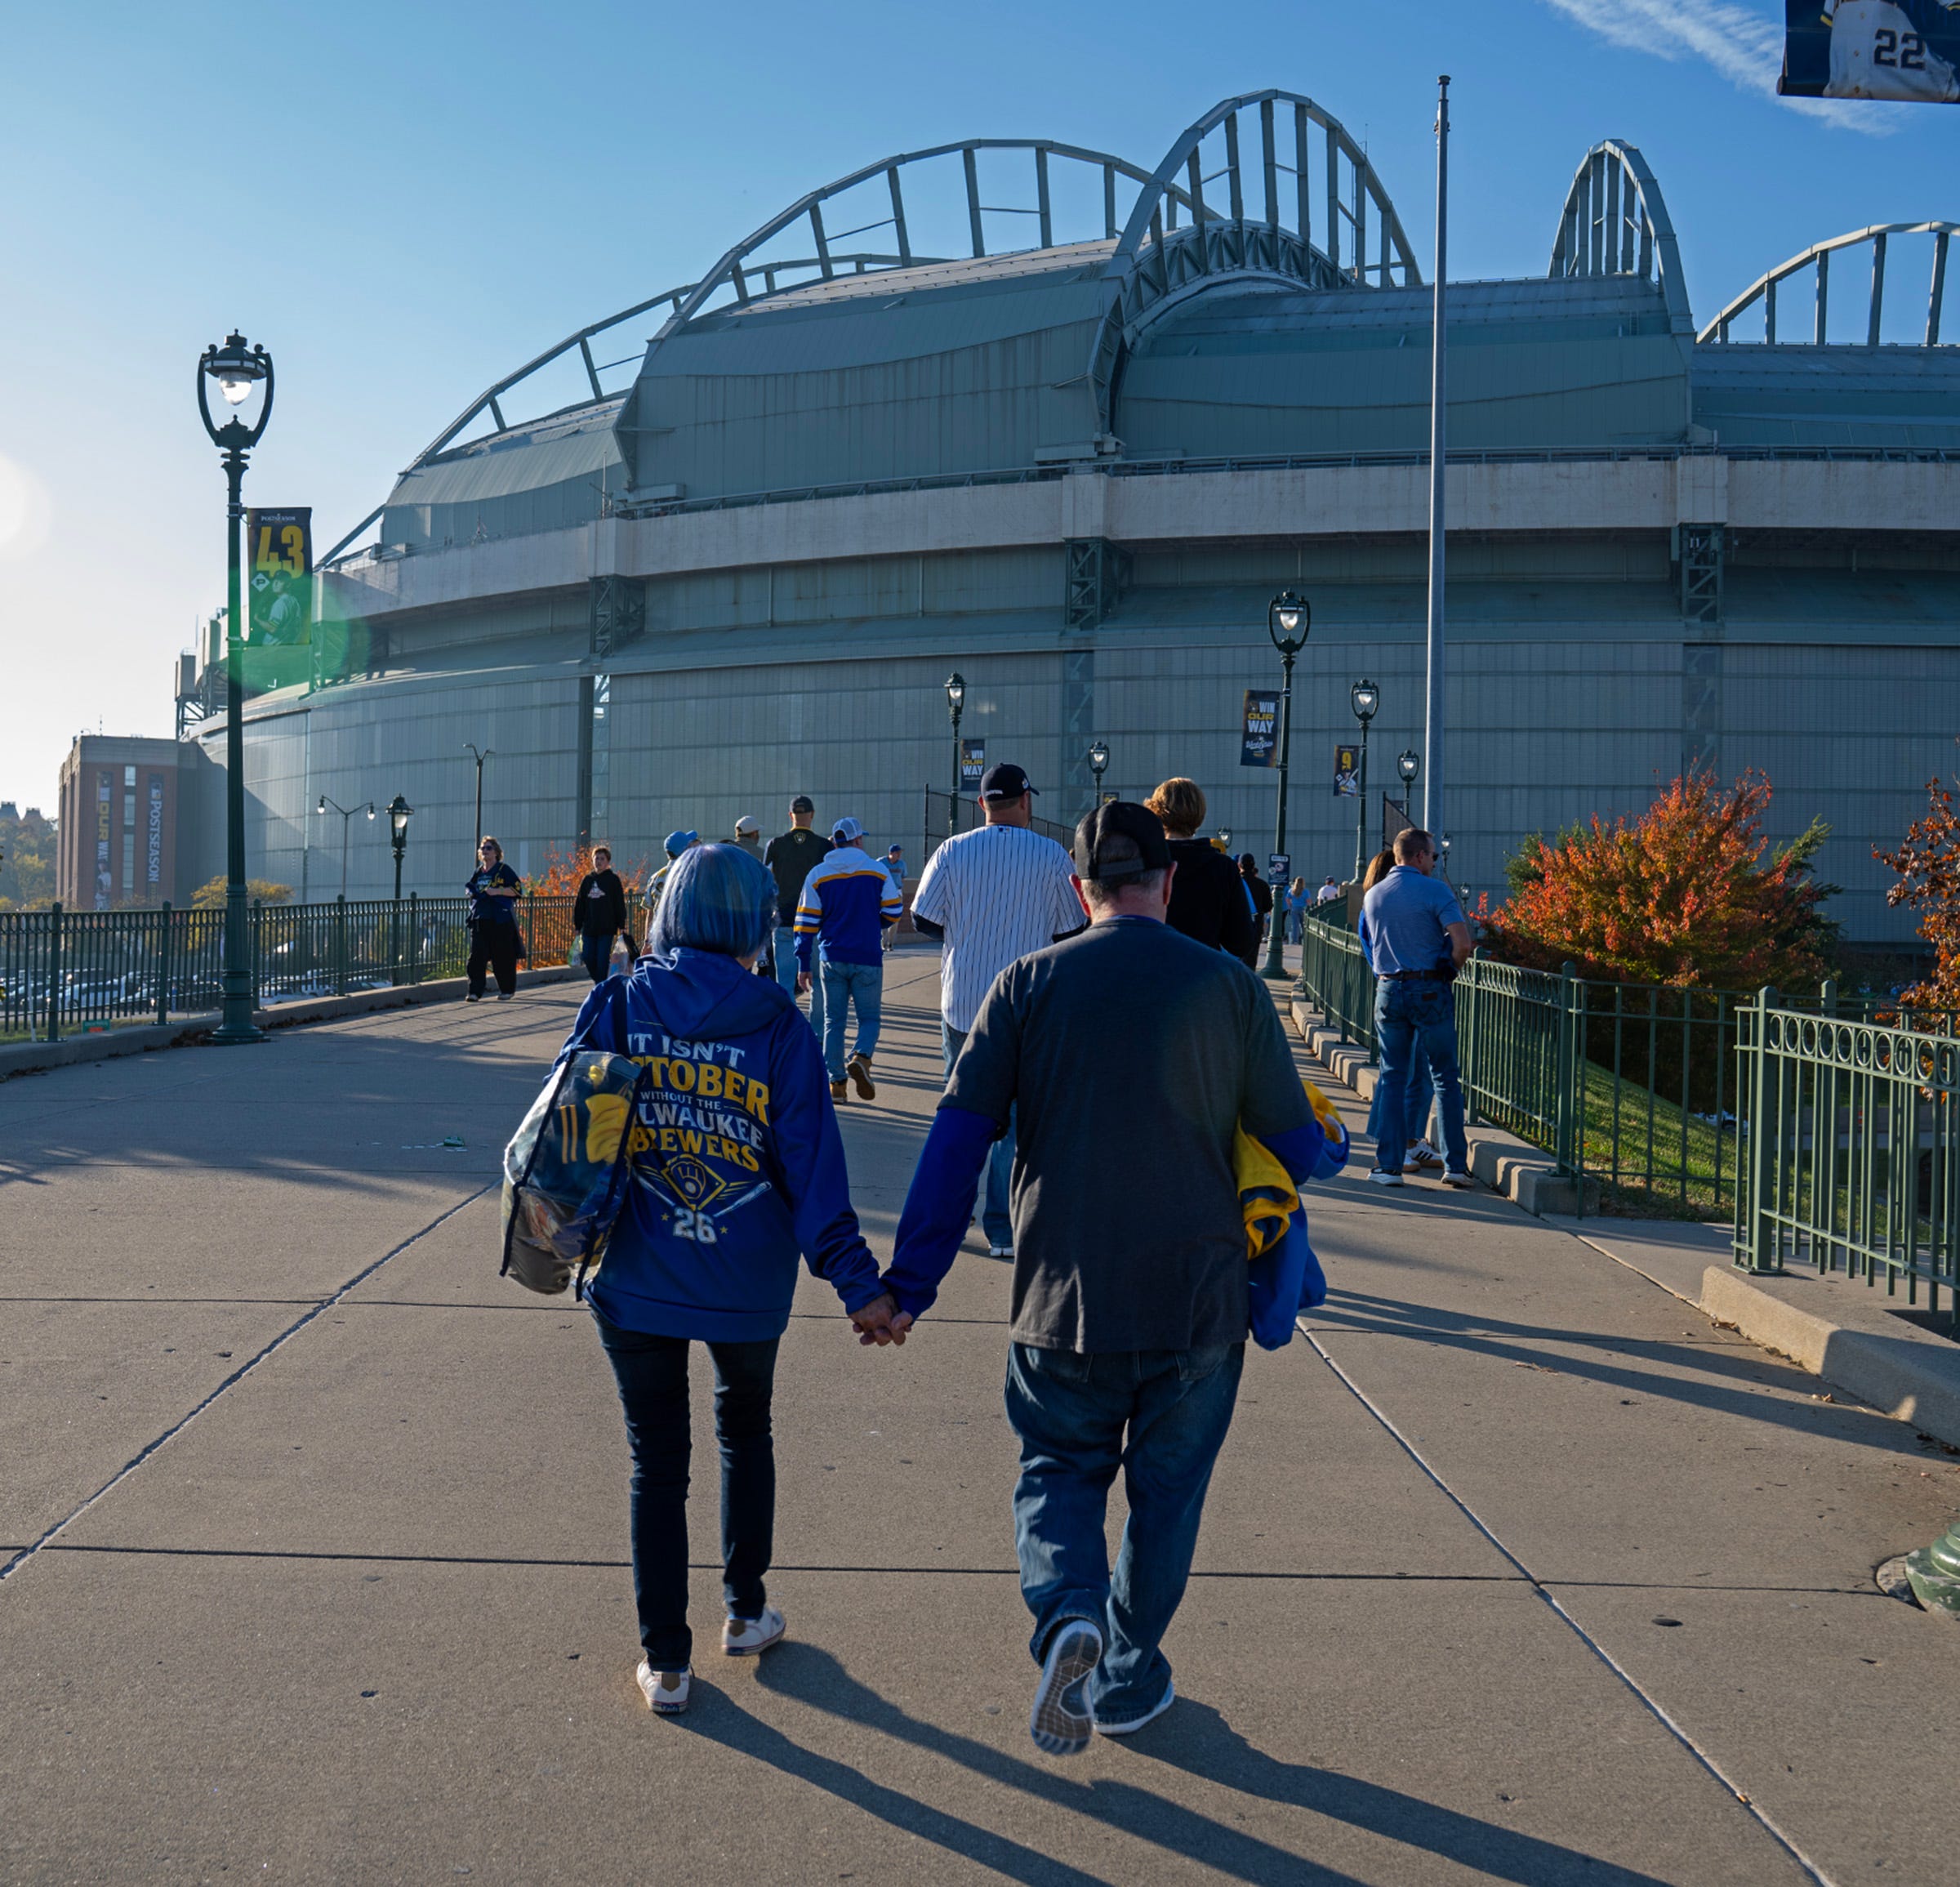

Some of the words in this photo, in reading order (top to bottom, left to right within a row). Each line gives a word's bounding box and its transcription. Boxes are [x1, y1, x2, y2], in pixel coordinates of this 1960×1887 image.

[1874, 28, 1925, 70] 22
[256, 525, 305, 579] 43
[1259, 701, 1275, 713] WIN
[1248, 720, 1274, 734] WAY
[962, 765, 983, 776] WAY
[1342, 752, 1352, 770] 9
[149, 801, 162, 882] POSTSEASON
[662, 1034, 746, 1069] ISN'T
[631, 1055, 769, 1126] TOBER
[640, 1091, 693, 1104] WITHOUT
[696, 1099, 722, 1111] THE
[635, 1103, 765, 1153] LWAUKEE
[673, 1207, 718, 1244] 26
